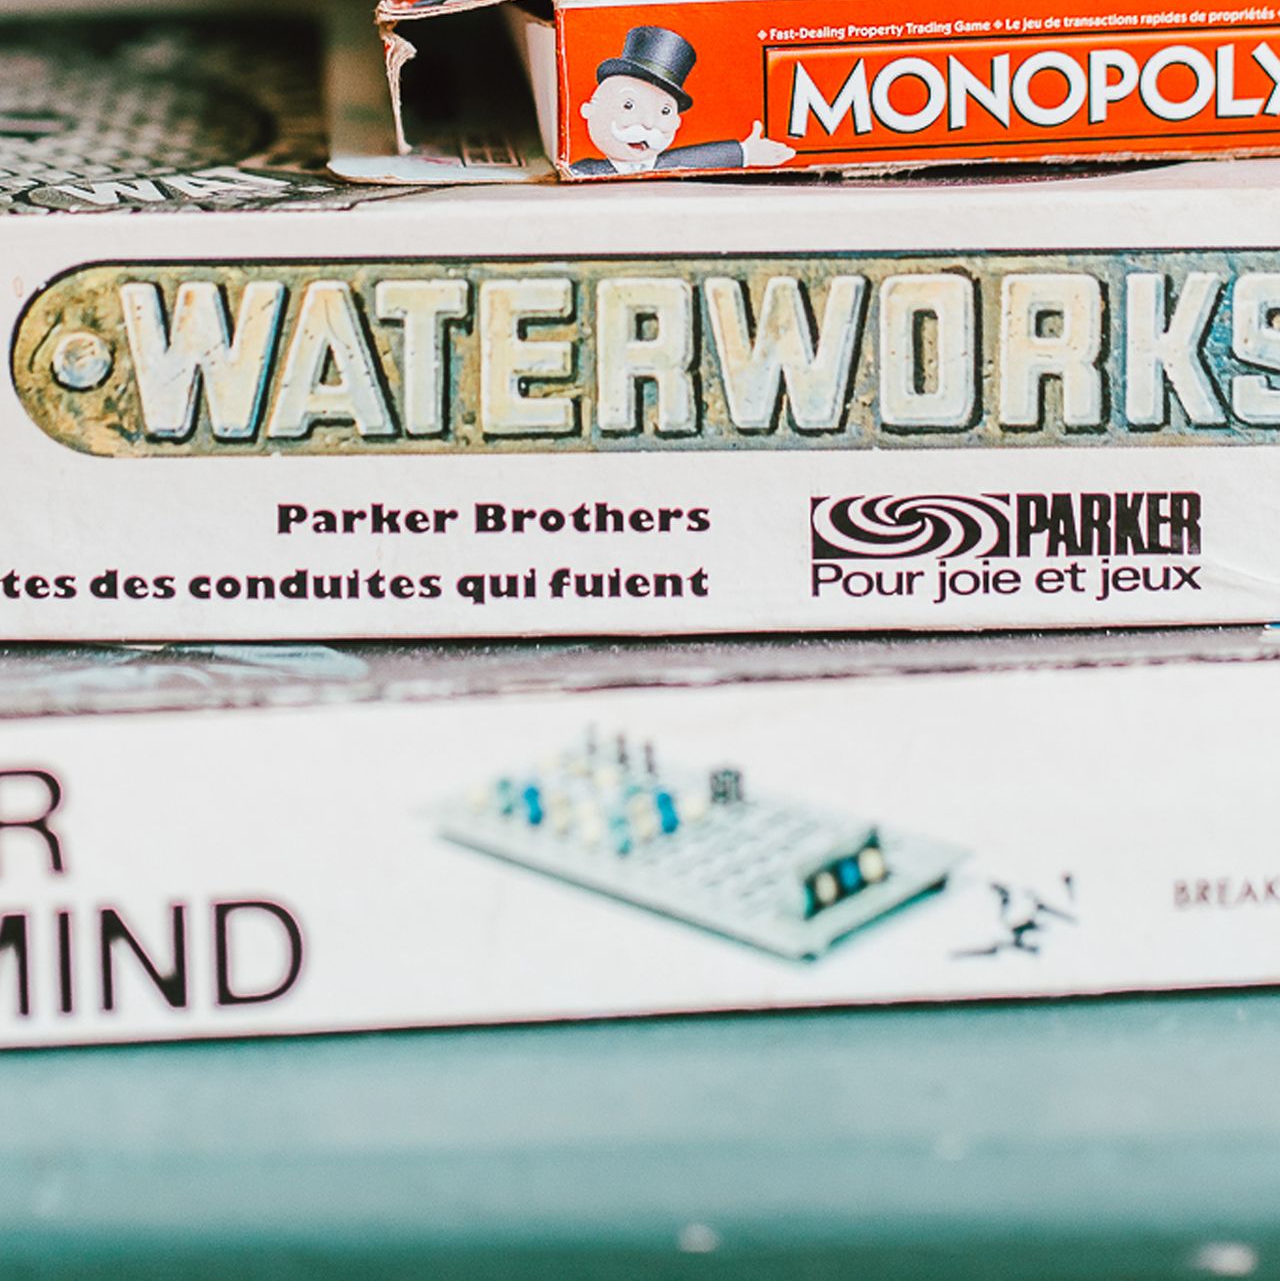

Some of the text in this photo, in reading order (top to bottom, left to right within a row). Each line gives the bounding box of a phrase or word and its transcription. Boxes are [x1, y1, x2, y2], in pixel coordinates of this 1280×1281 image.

[848, 25, 903, 38] Property
[906, 22, 952, 35] Trading
[954, 20, 991, 32] Game
[1005, 19, 1020, 30] Le
[1022, 17, 1042, 31] jeu
[1044, 16, 1061, 28] de
[1064, 13, 1138, 27] transactions
[1141, 11, 1187, 26] rapides
[1189, 10, 1207, 22] de
[1208, 7, 1275, 23] propriétés
[277, 502, 711, 535] Parker Brothers
[1016, 492, 1202, 557] PARKER
[89, 569, 176, 600] des
[188, 568, 442, 600] conduites
[456, 567, 537, 605] qui
[548, 567, 709, 599] fuient
[811, 558, 1202, 604] Pour joie et jeux
